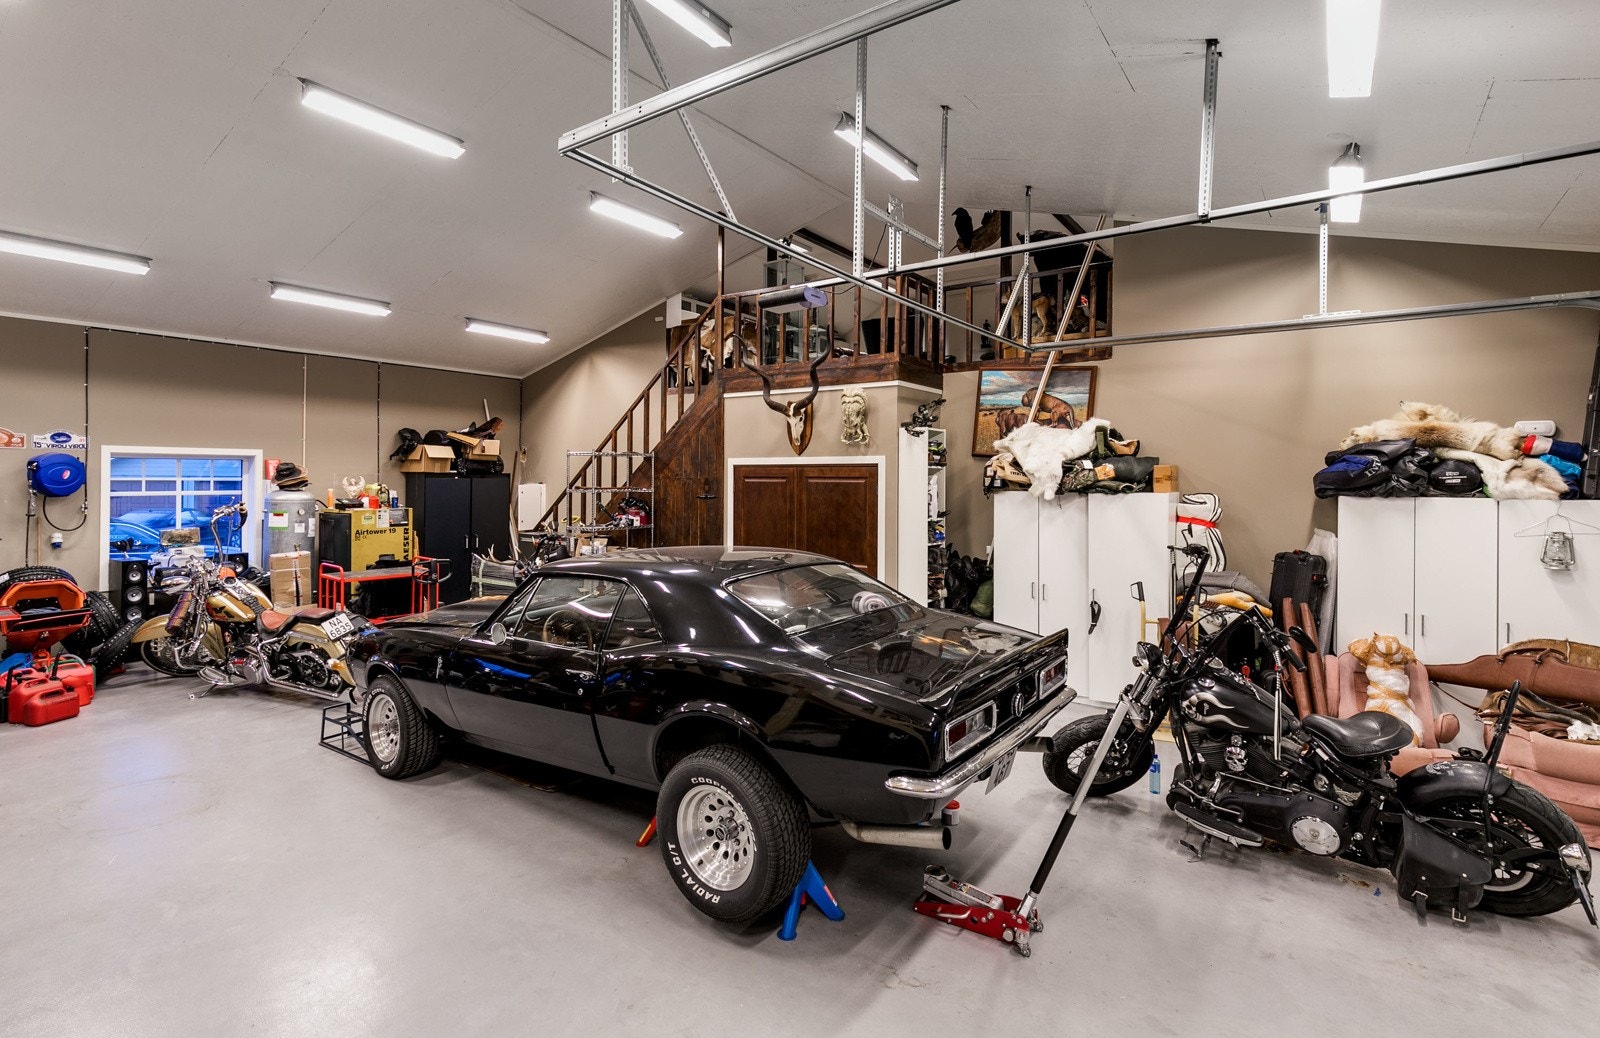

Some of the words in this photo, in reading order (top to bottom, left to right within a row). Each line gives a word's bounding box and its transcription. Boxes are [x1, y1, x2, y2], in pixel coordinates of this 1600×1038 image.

[328, 617, 343, 628] NA
[329, 622, 352, 638] 6835
[690, 777, 735, 798] COOPER
[681, 868, 722, 904] RADIAL
